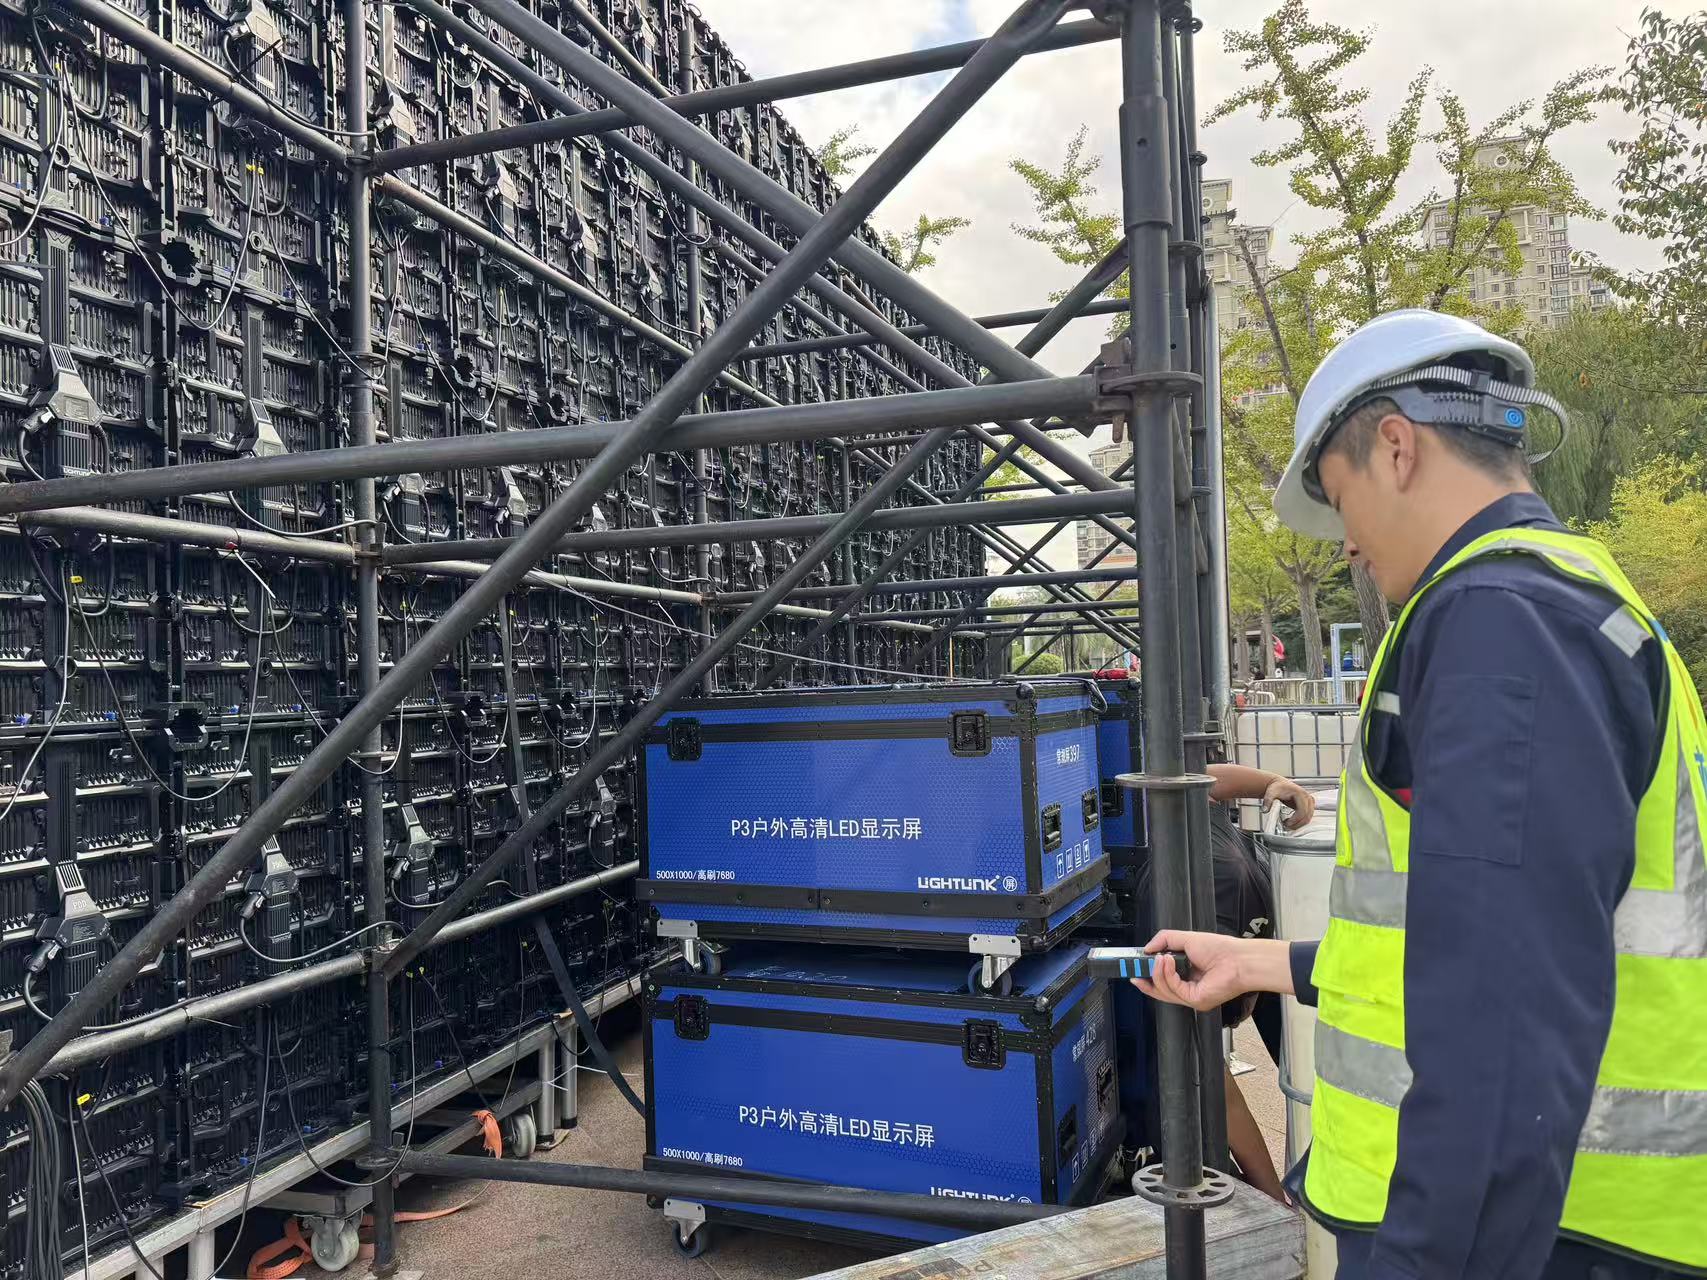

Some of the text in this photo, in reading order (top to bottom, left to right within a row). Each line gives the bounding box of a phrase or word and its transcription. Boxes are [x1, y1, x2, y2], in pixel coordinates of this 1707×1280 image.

[731, 817, 922, 840] P3户外高清LED显示屏
[656, 869, 735, 881] 500X1000/高刷7680
[739, 1106, 935, 1148] P3户外高清LED显示屏
[662, 1147, 743, 1167] 500X1000/高刷7680
